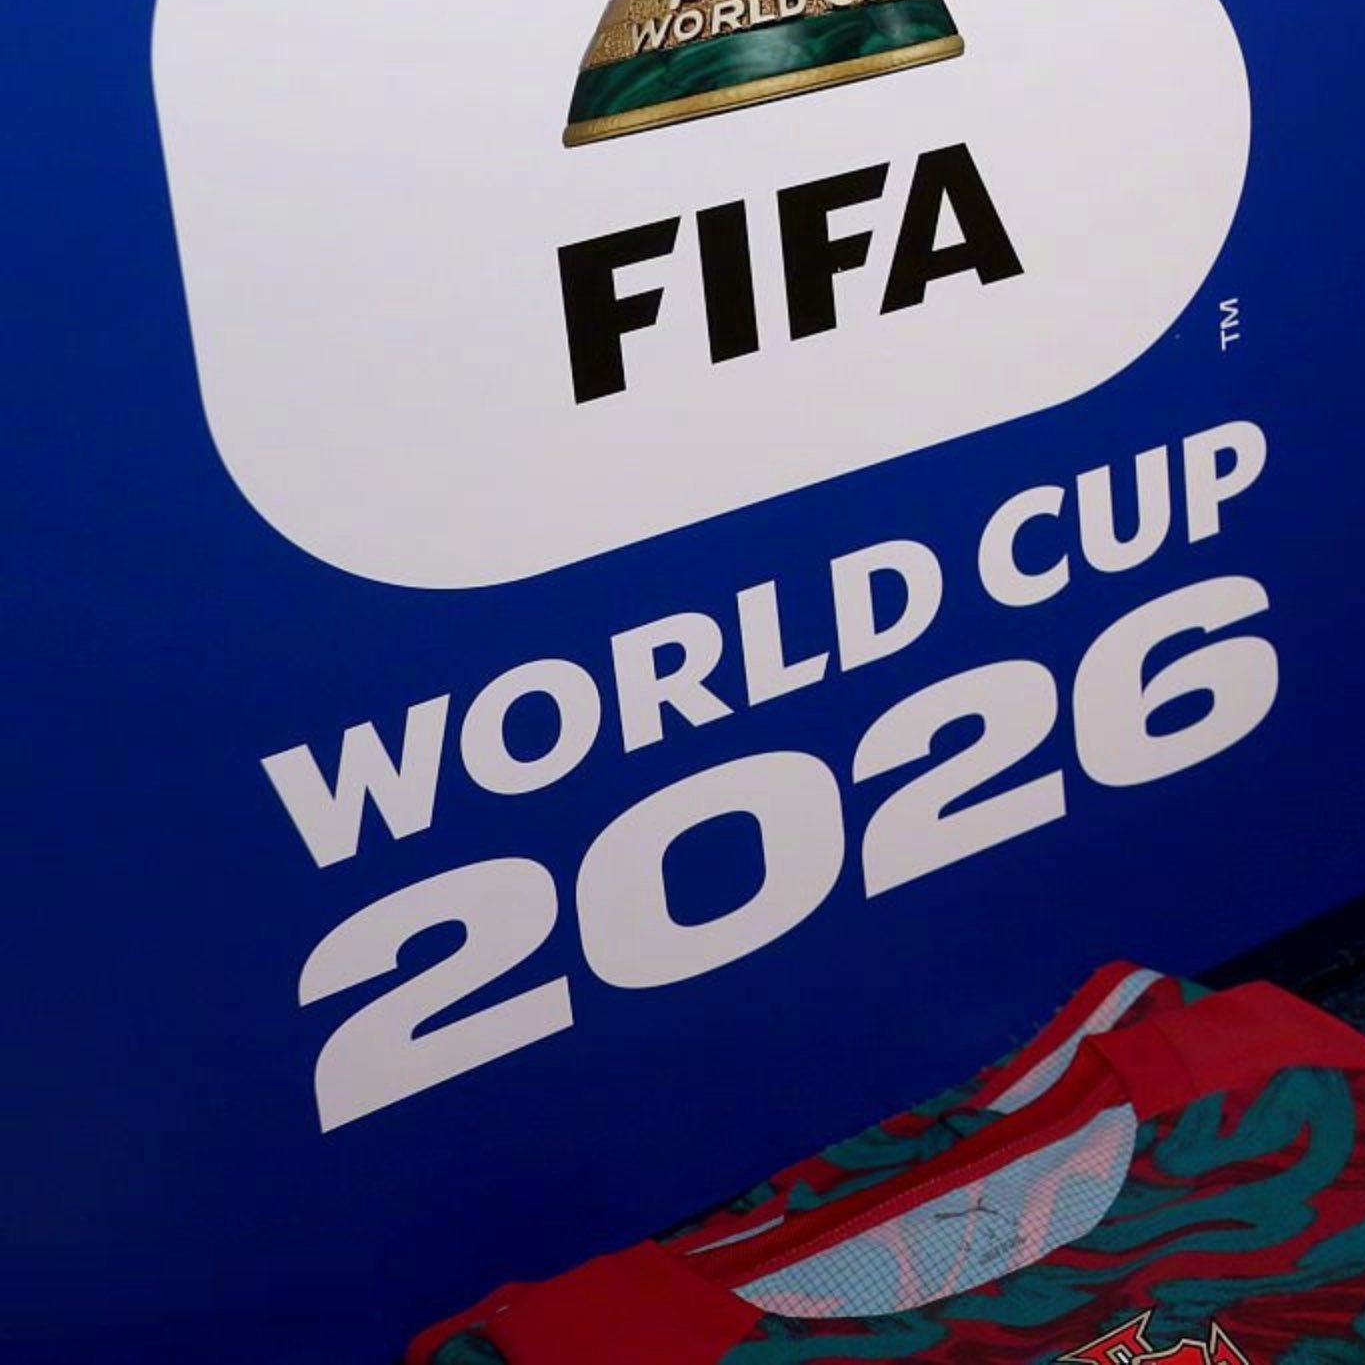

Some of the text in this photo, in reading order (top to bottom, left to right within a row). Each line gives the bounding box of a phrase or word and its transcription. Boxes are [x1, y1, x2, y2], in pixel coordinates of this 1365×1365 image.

[557, 142, 1024, 404] FIFA
[1219, 297, 1240, 351] TM
[260, 420, 1267, 868] WORLD CUP
[298, 575, 1279, 1134] 2026
